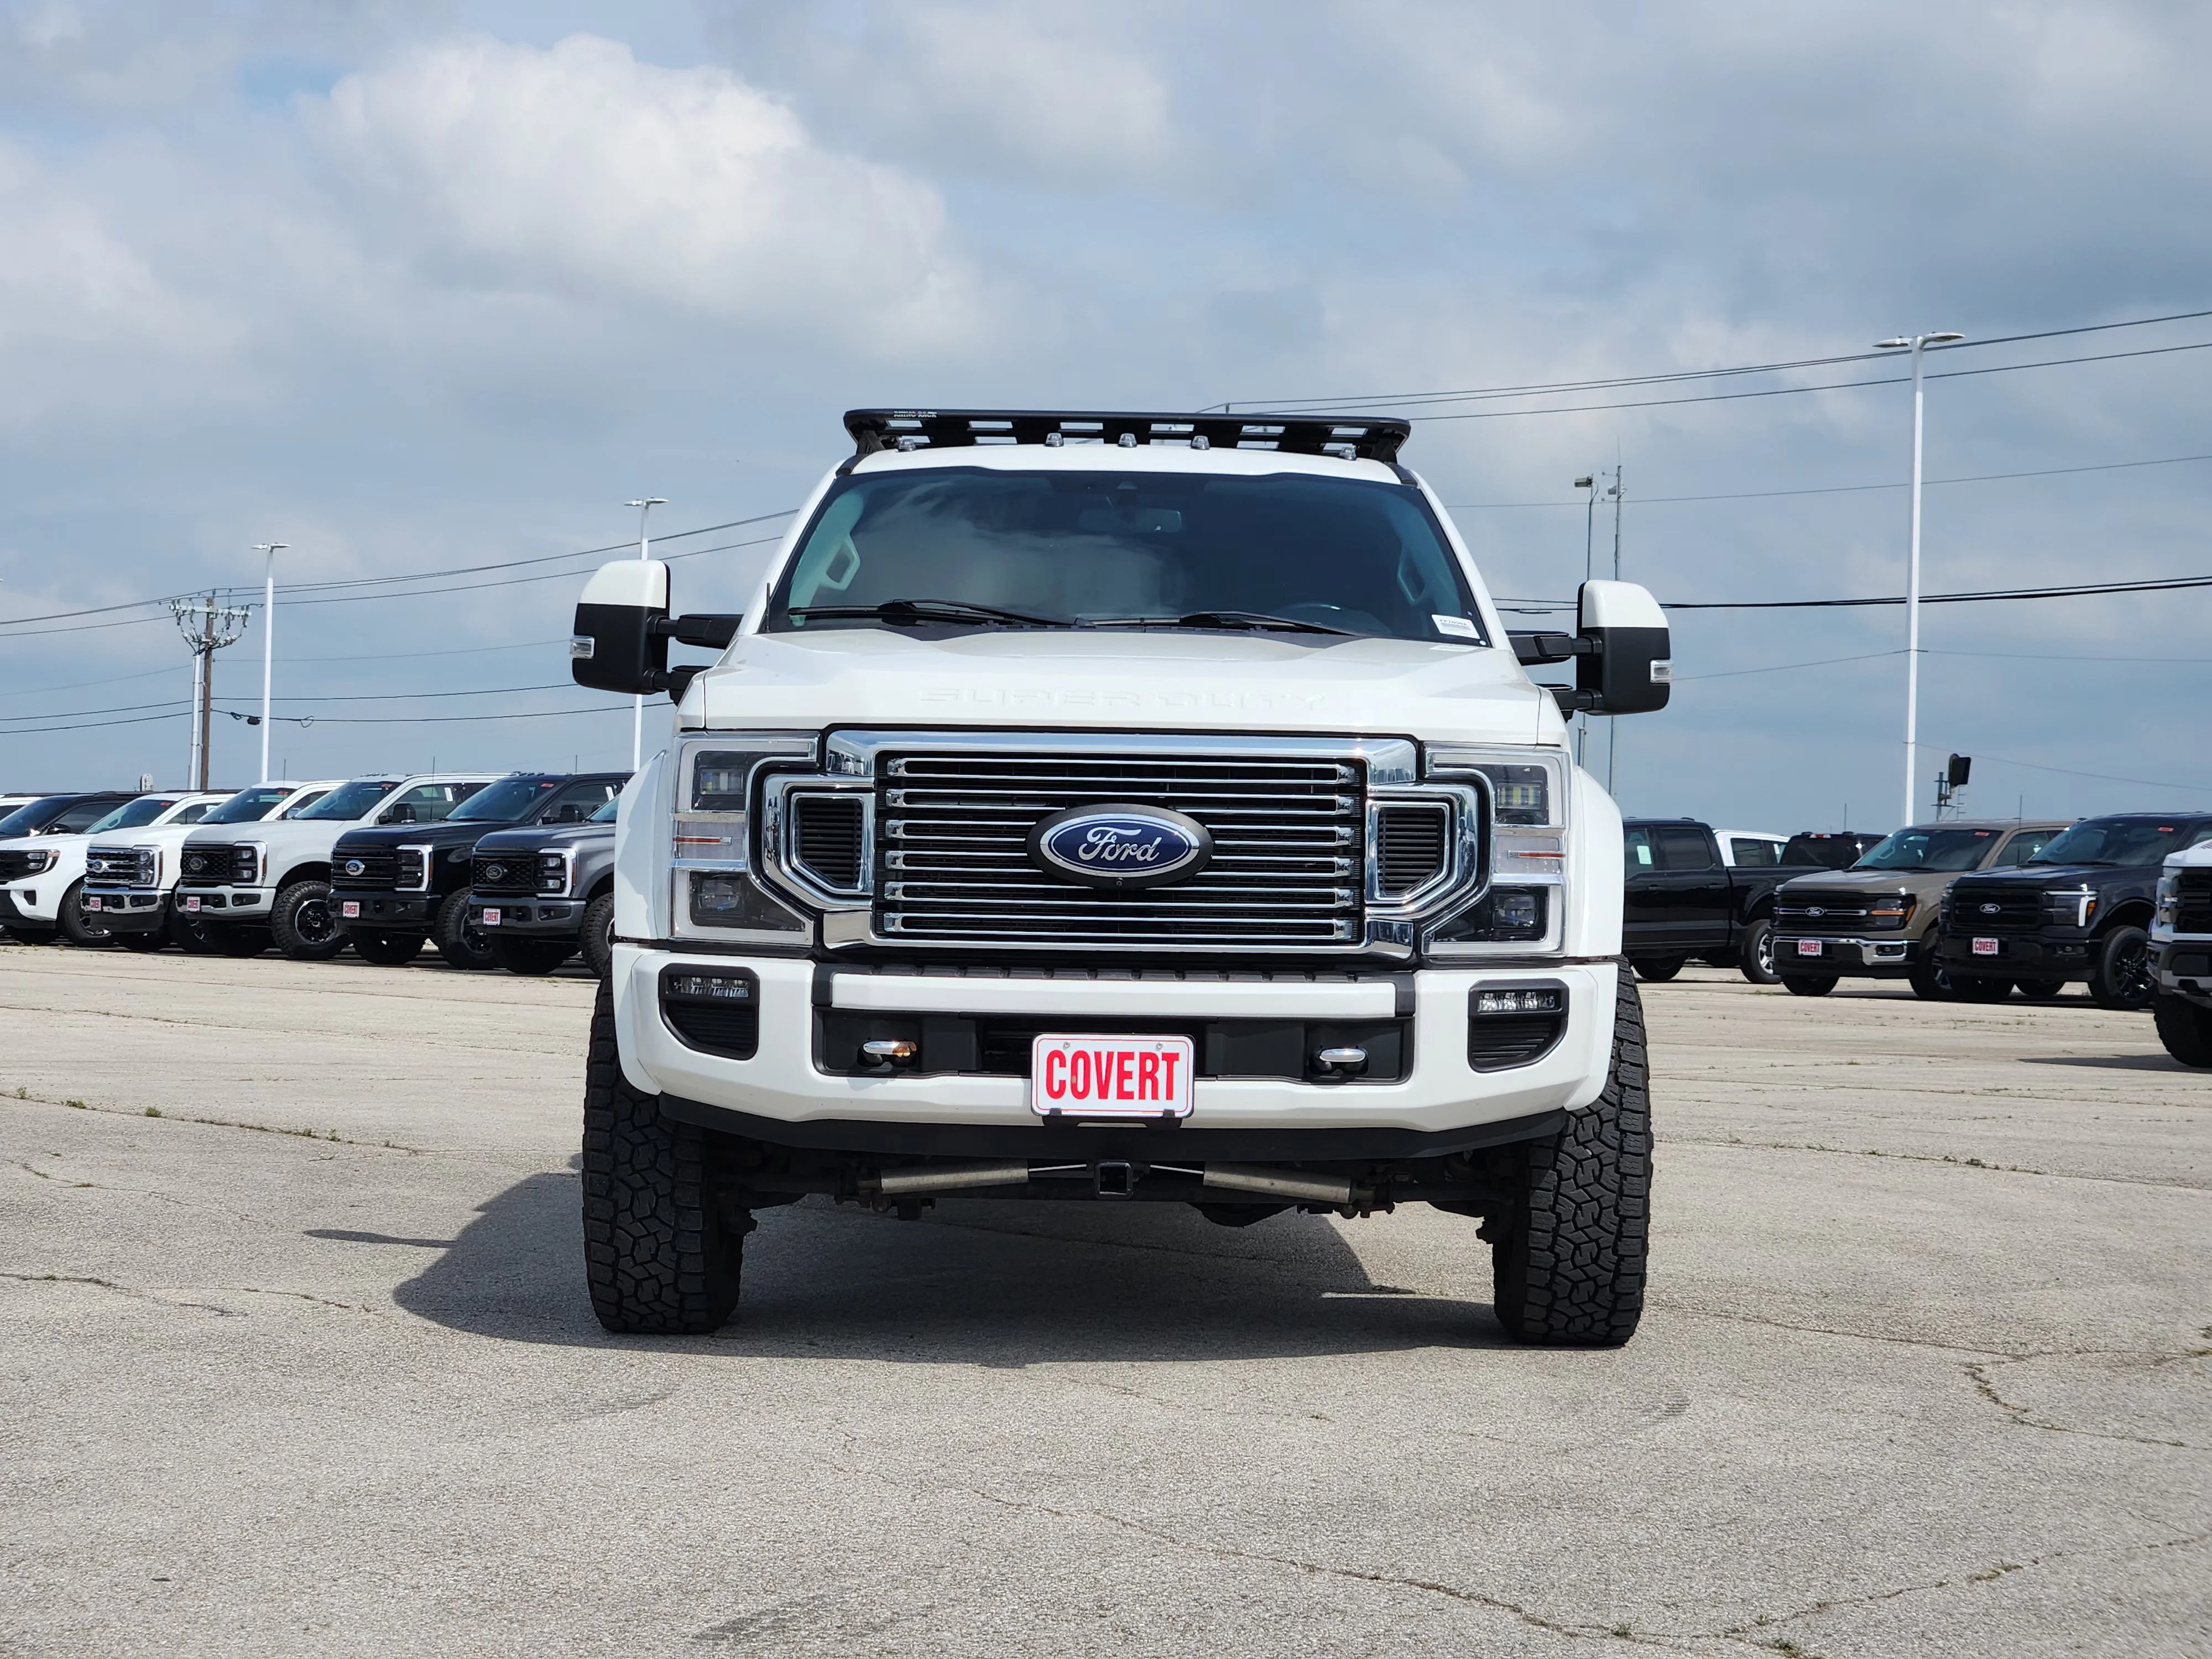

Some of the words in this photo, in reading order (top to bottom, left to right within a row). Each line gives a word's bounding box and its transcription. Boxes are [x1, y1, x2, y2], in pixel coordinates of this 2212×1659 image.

[919, 688, 1140, 707] SUPER
[1156, 691, 1326, 710] DUTY
[1078, 827, 1162, 862] Ford
[1801, 942, 1820, 952] COVERT
[1975, 941, 1996, 951] COVERT
[1046, 1050, 1180, 1100] COVERT
